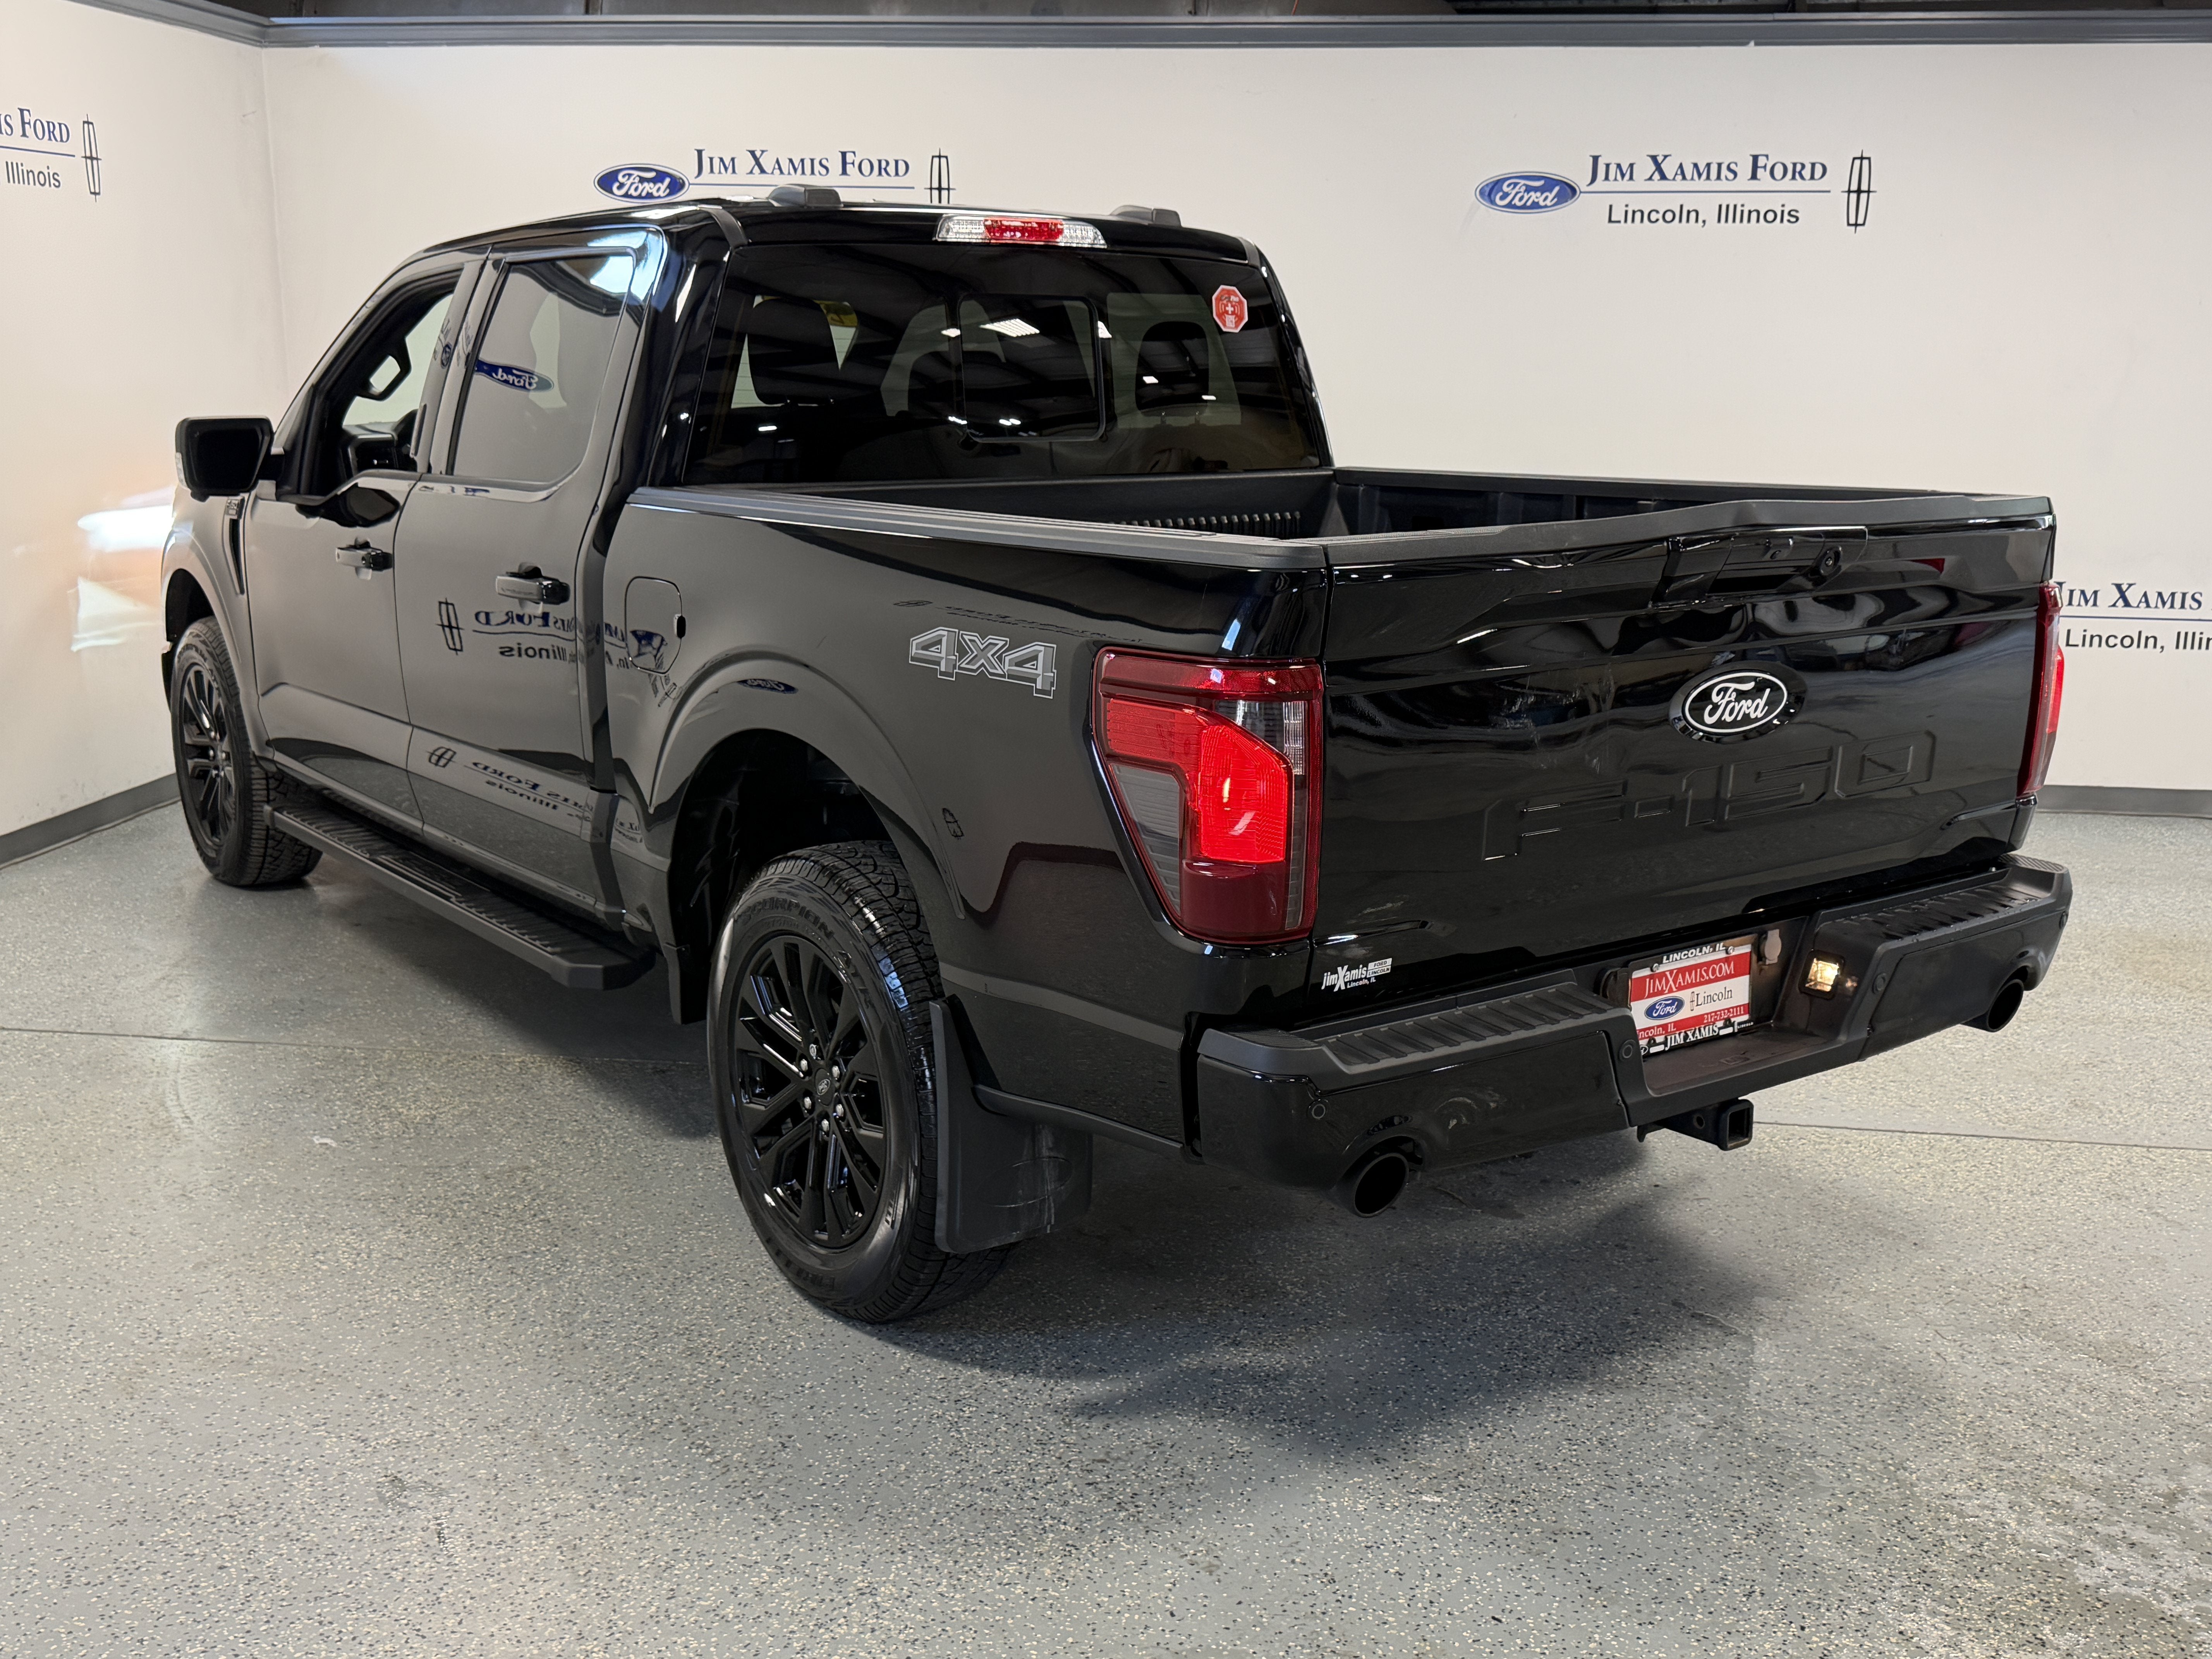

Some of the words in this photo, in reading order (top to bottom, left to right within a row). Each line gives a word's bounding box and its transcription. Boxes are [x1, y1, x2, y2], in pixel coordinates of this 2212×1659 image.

[17, 107, 70, 143] FORD
[5, 161, 61, 188] Illinois
[694, 149, 737, 179] JIM
[746, 149, 830, 176] XAMIS
[838, 150, 910, 177] FORD
[1586, 155, 1636, 187] JIM
[1644, 154, 1738, 181] XAMIS
[1747, 154, 1827, 181] FORD
[612, 169, 671, 197] Ford
[1495, 179, 1560, 206] Ford
[1608, 204, 1706, 227] Lincoln,
[1717, 203, 1800, 224] Illinois
[2108, 582, 2203, 610] XAMIS
[2065, 629, 2165, 653] Lincoln,
[1704, 681, 1771, 725] Ford
[1482, 730, 1936, 862] F-150
[1662, 945, 1713, 963] LINCOLN,
[1716, 942, 1726, 951] IL
[1347, 978, 1369, 989] Lincoln,
[1644, 961, 1735, 998] JIMXAMIS.COM
[1652, 1000, 1678, 1017] Ford
[1695, 986, 1733, 1007] Lincoln
[1668, 1023, 1676, 1032] IL
[1704, 1006, 1744, 1023] 217-732-2111
[1665, 1033, 1684, 1051] JIM
[1686, 1024, 1719, 1042] XAMIS
